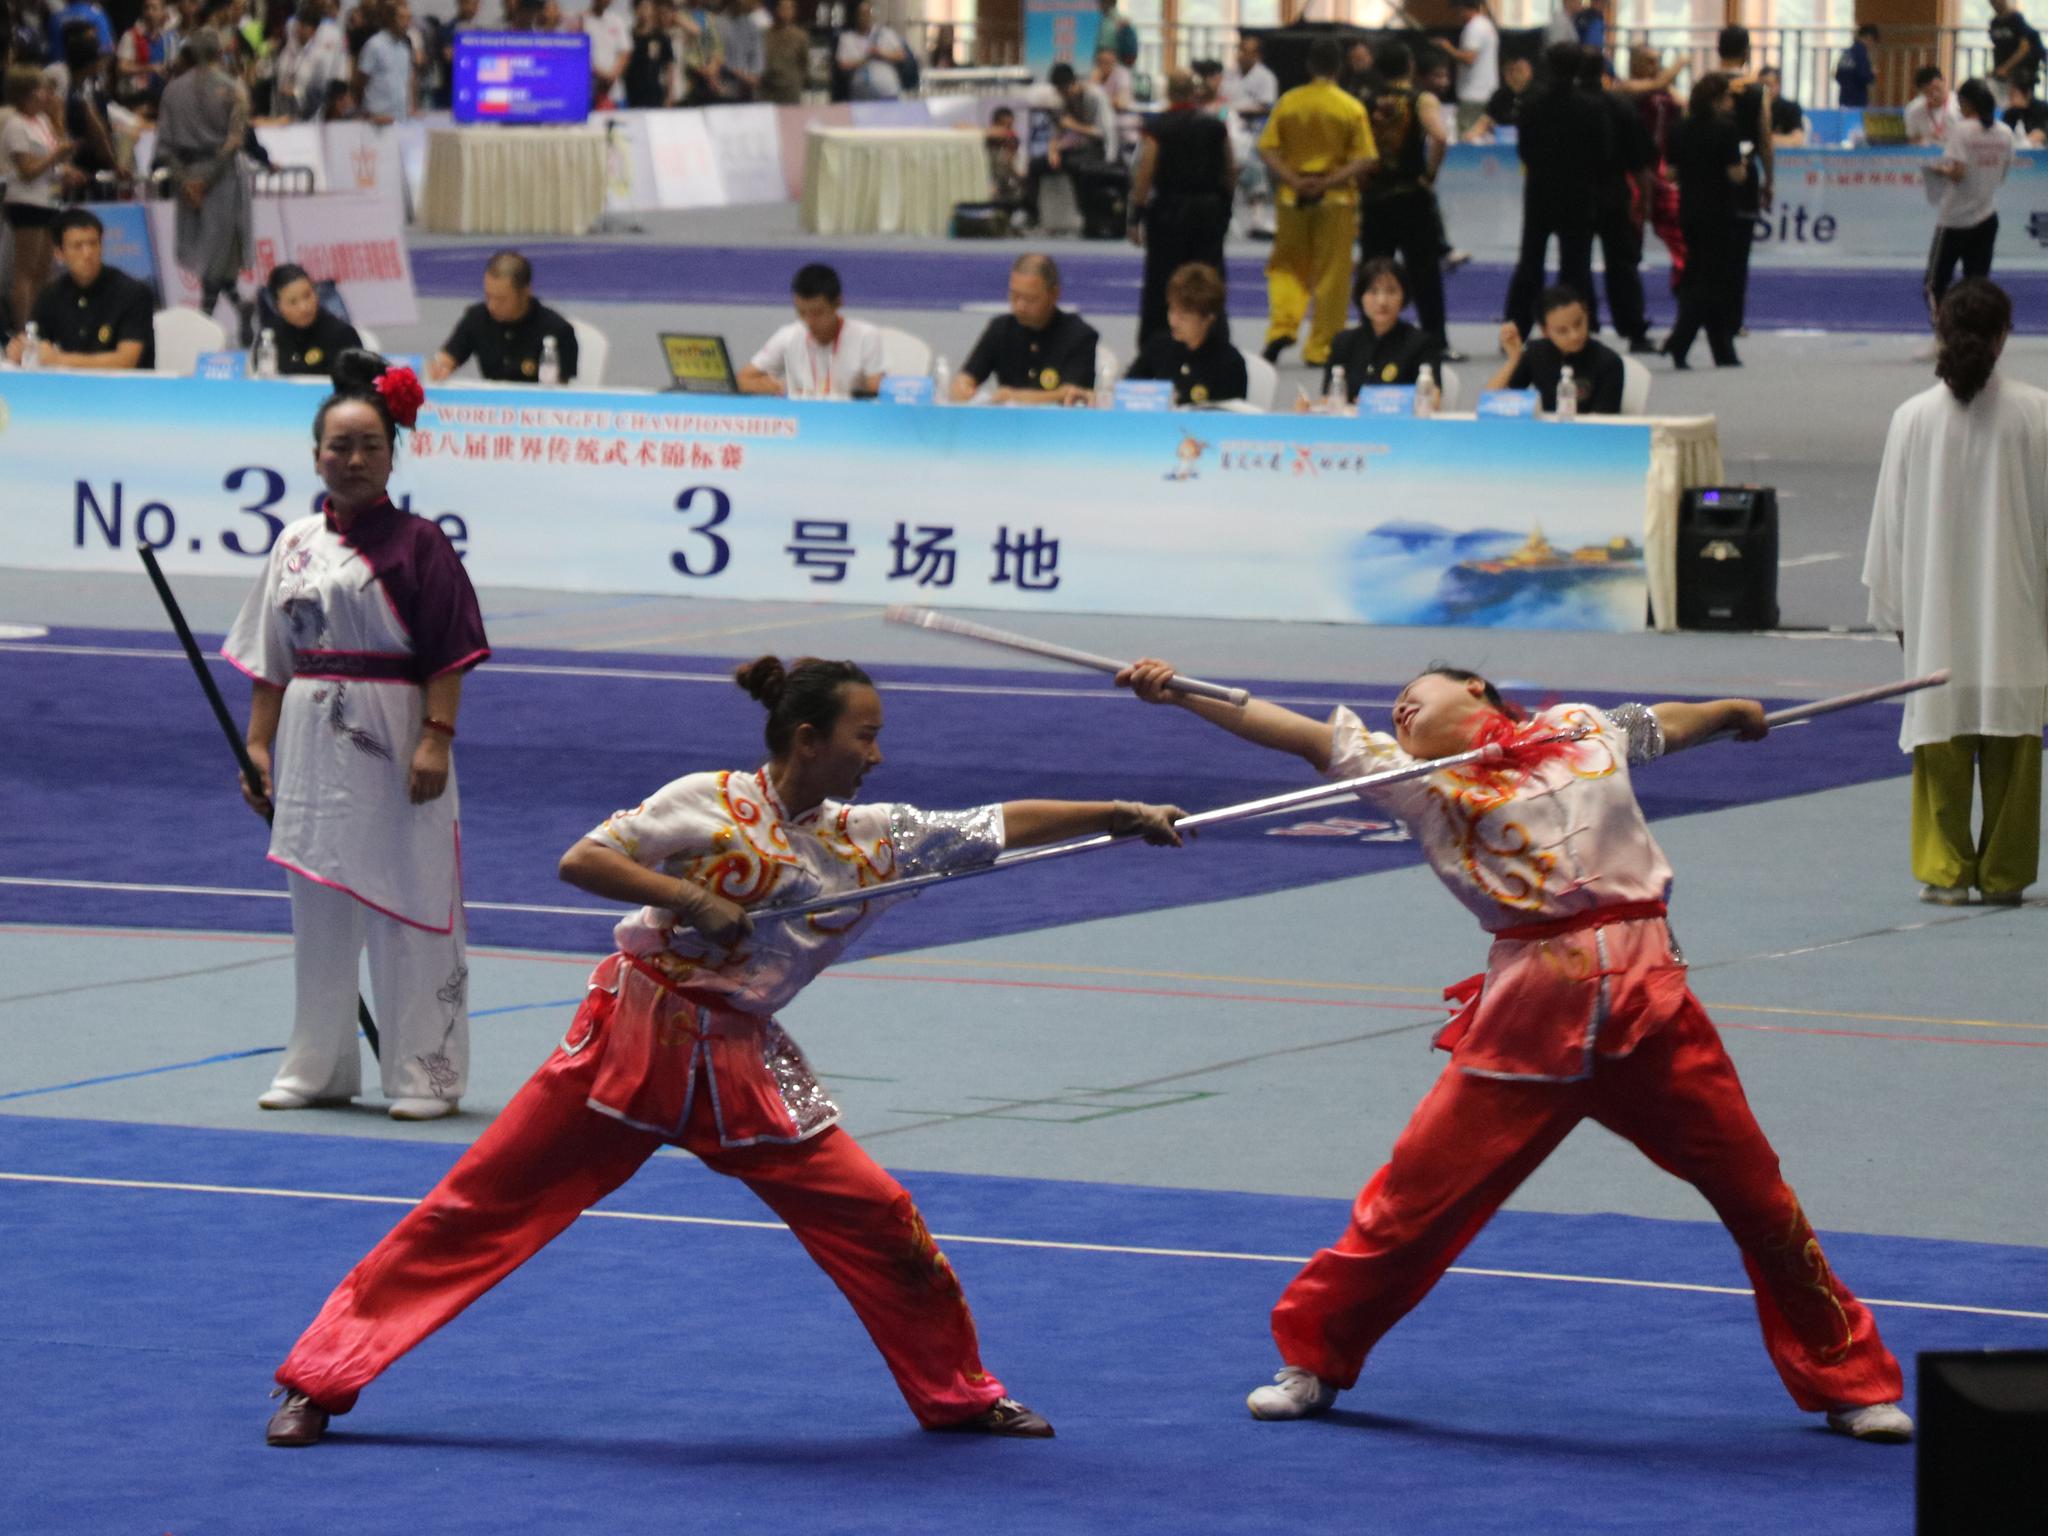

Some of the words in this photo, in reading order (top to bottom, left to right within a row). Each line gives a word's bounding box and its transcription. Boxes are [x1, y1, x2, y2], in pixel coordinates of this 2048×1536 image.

[437, 406, 515, 425] WORLD
[520, 408, 609, 429] KUNGFU
[614, 413, 796, 436] CHAMPIONSHIPS
